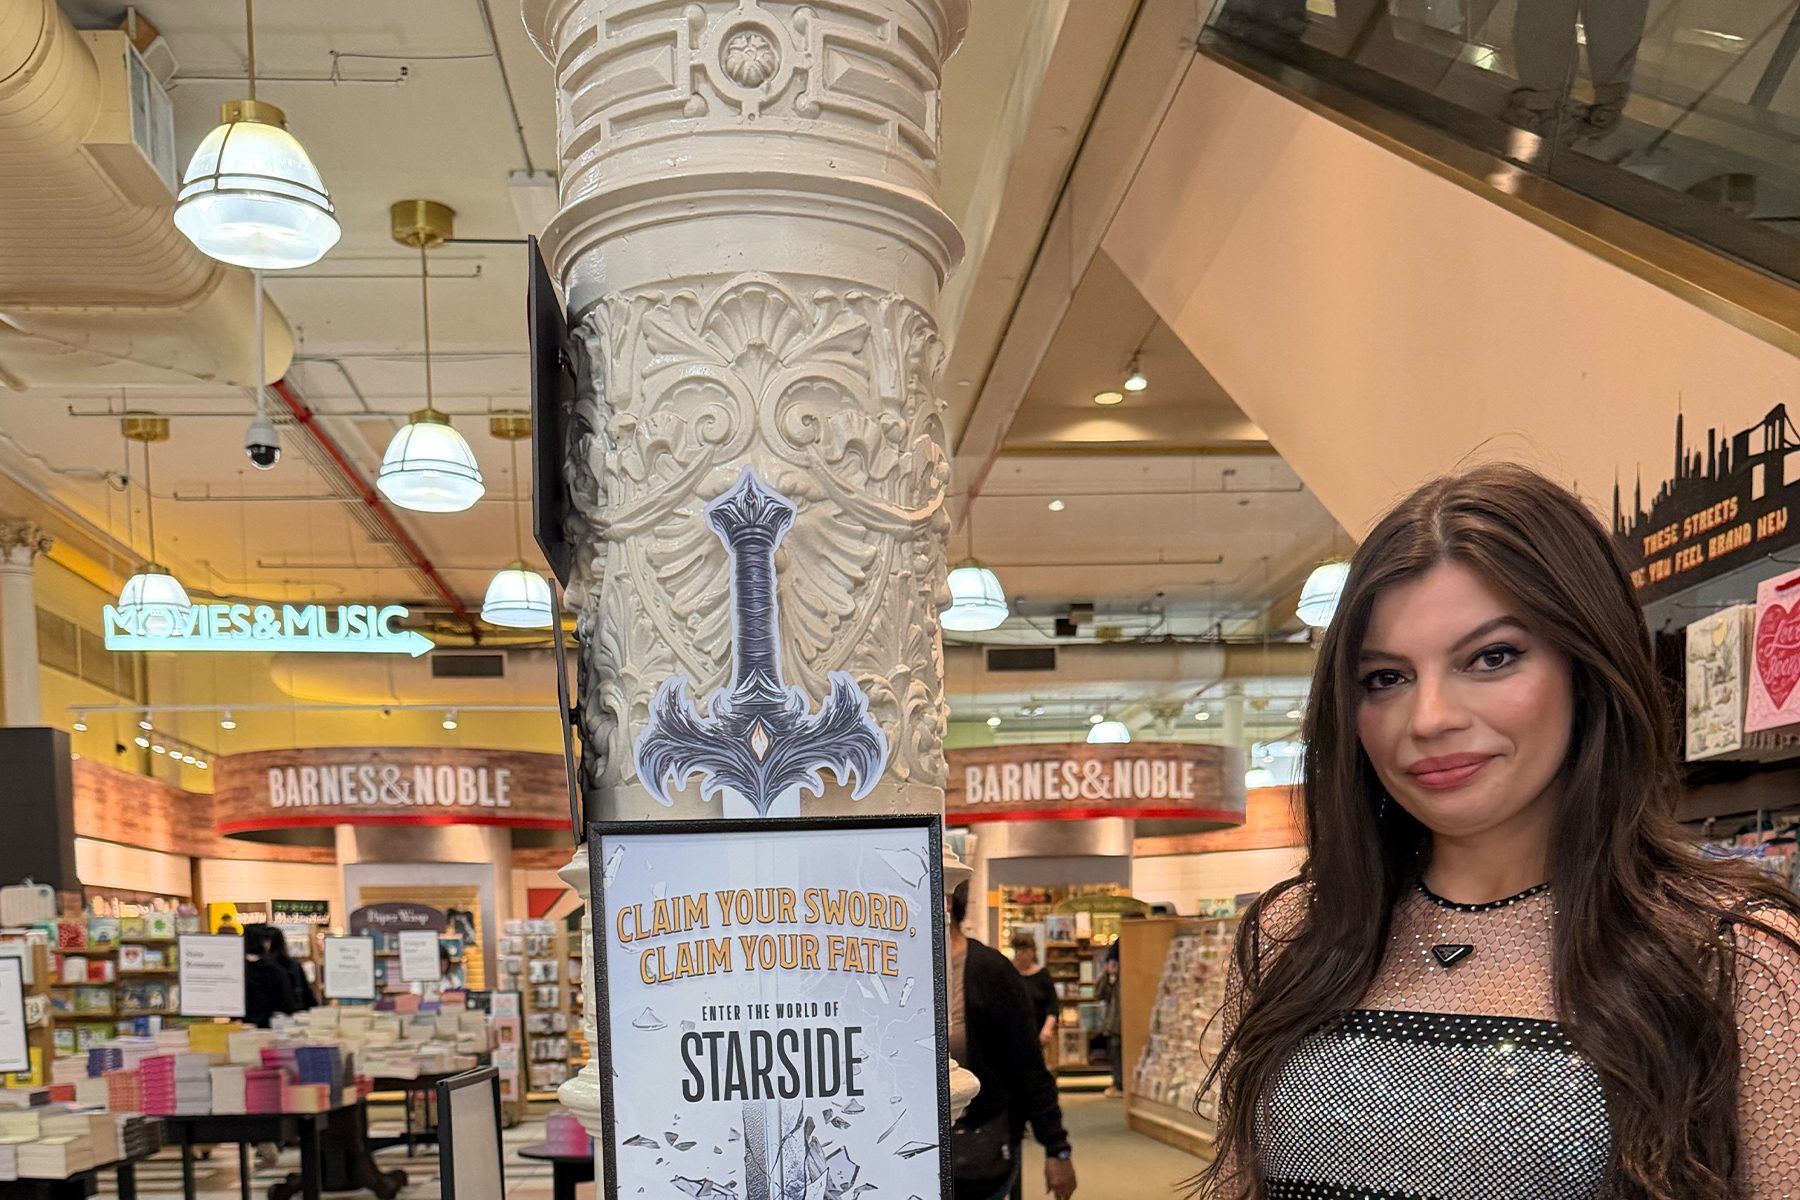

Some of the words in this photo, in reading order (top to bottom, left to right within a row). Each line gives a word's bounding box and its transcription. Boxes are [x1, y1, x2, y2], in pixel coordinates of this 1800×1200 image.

[1643, 523, 1679, 557] THESE
[1683, 495, 1738, 540] STREETS
[1648, 556, 1672, 584] YOU
[1674, 543, 1704, 574] FEEL
[1708, 522, 1752, 561] BRAND
[1756, 506, 1788, 542] NEW
[268, 763, 512, 808] BARNES&NOBLE
[965, 758, 1195, 804] BARNES&NOBLE
[616, 891, 710, 944] CLAIM
[715, 887, 797, 927] YOUR
[803, 888, 917, 938] SWORD,
[639, 936, 732, 985] CLAIM
[741, 934, 821, 971] YOUR
[827, 935, 899, 978] FATE
[701, 1004, 741, 1021] ENTER
[747, 1003, 770, 1021] THE
[775, 1002, 819, 1019] WORLD
[824, 1001, 839, 1018] OF
[680, 1026, 865, 1103] STARSIDE
